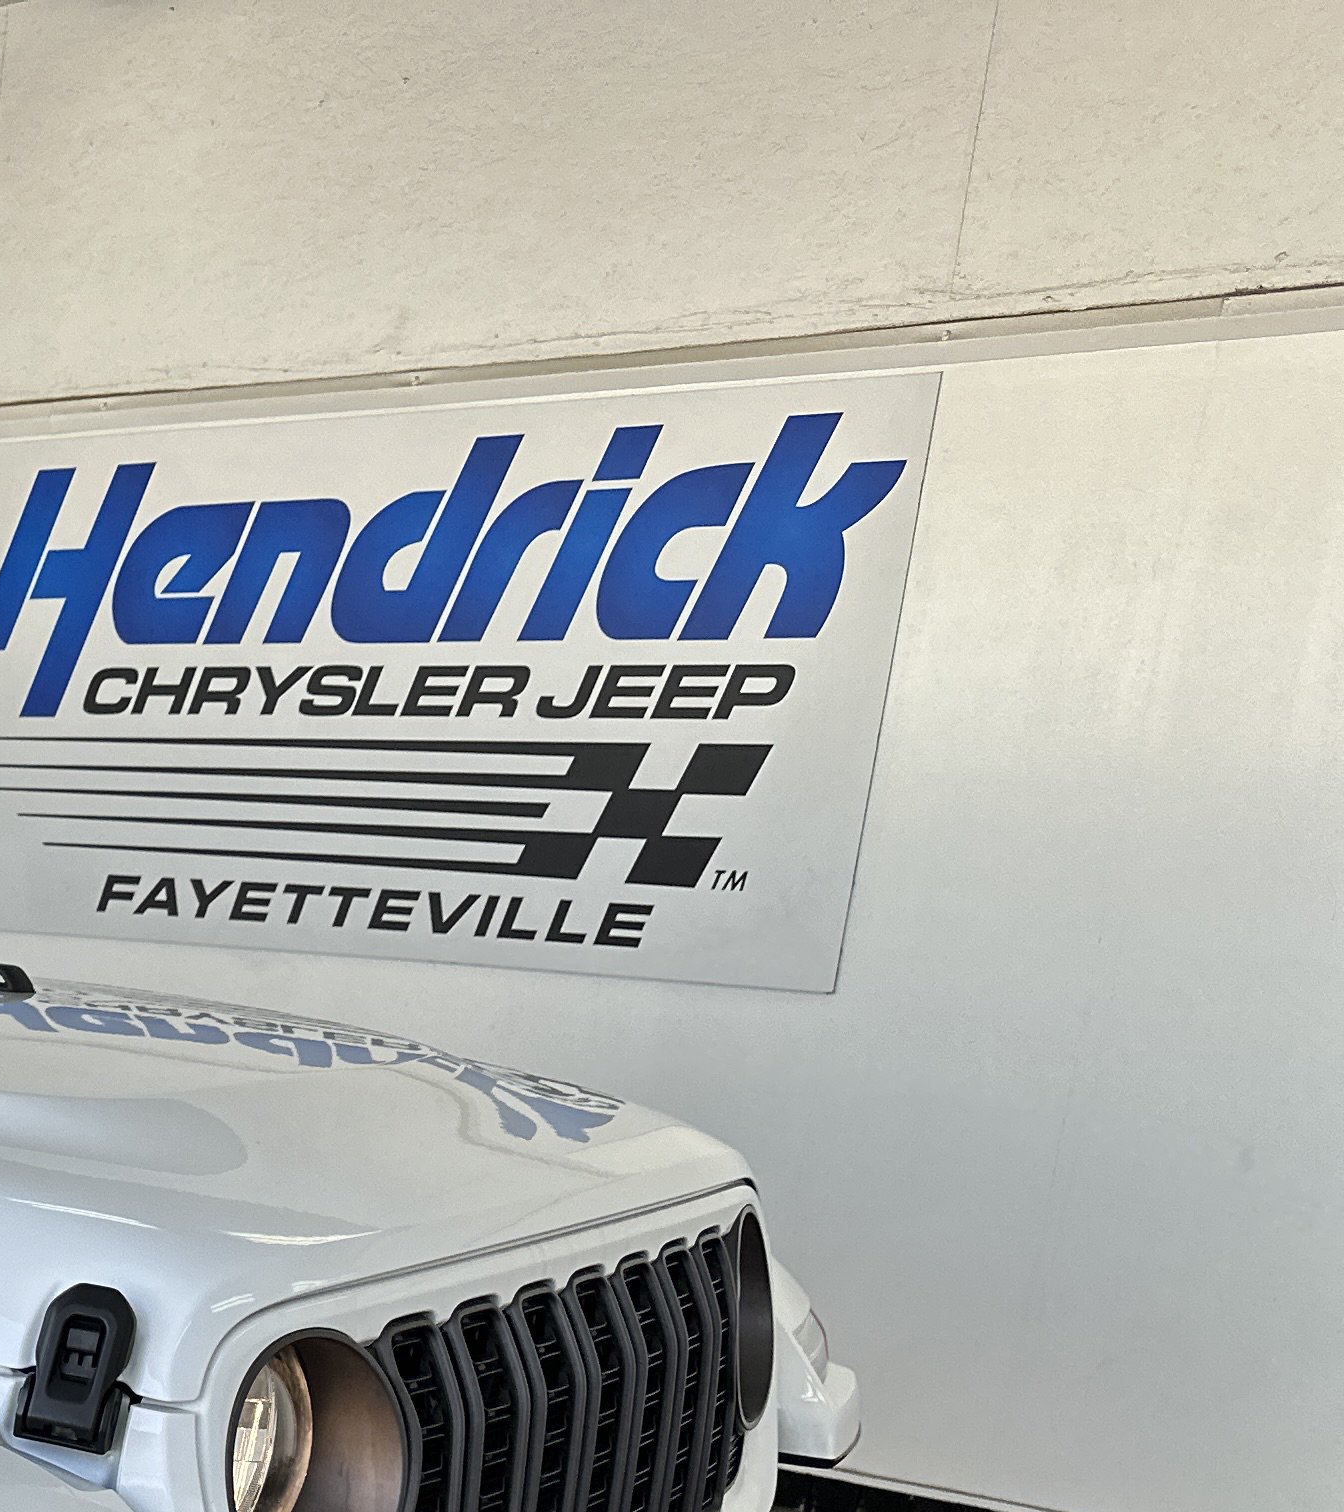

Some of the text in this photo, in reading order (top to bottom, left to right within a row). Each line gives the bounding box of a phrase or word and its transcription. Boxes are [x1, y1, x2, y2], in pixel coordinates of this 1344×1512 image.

[82, 663, 797, 721] CHRYSLER JEEP
[711, 869, 748, 892] TM
[95, 876, 655, 949] FAYETTEVILLE
